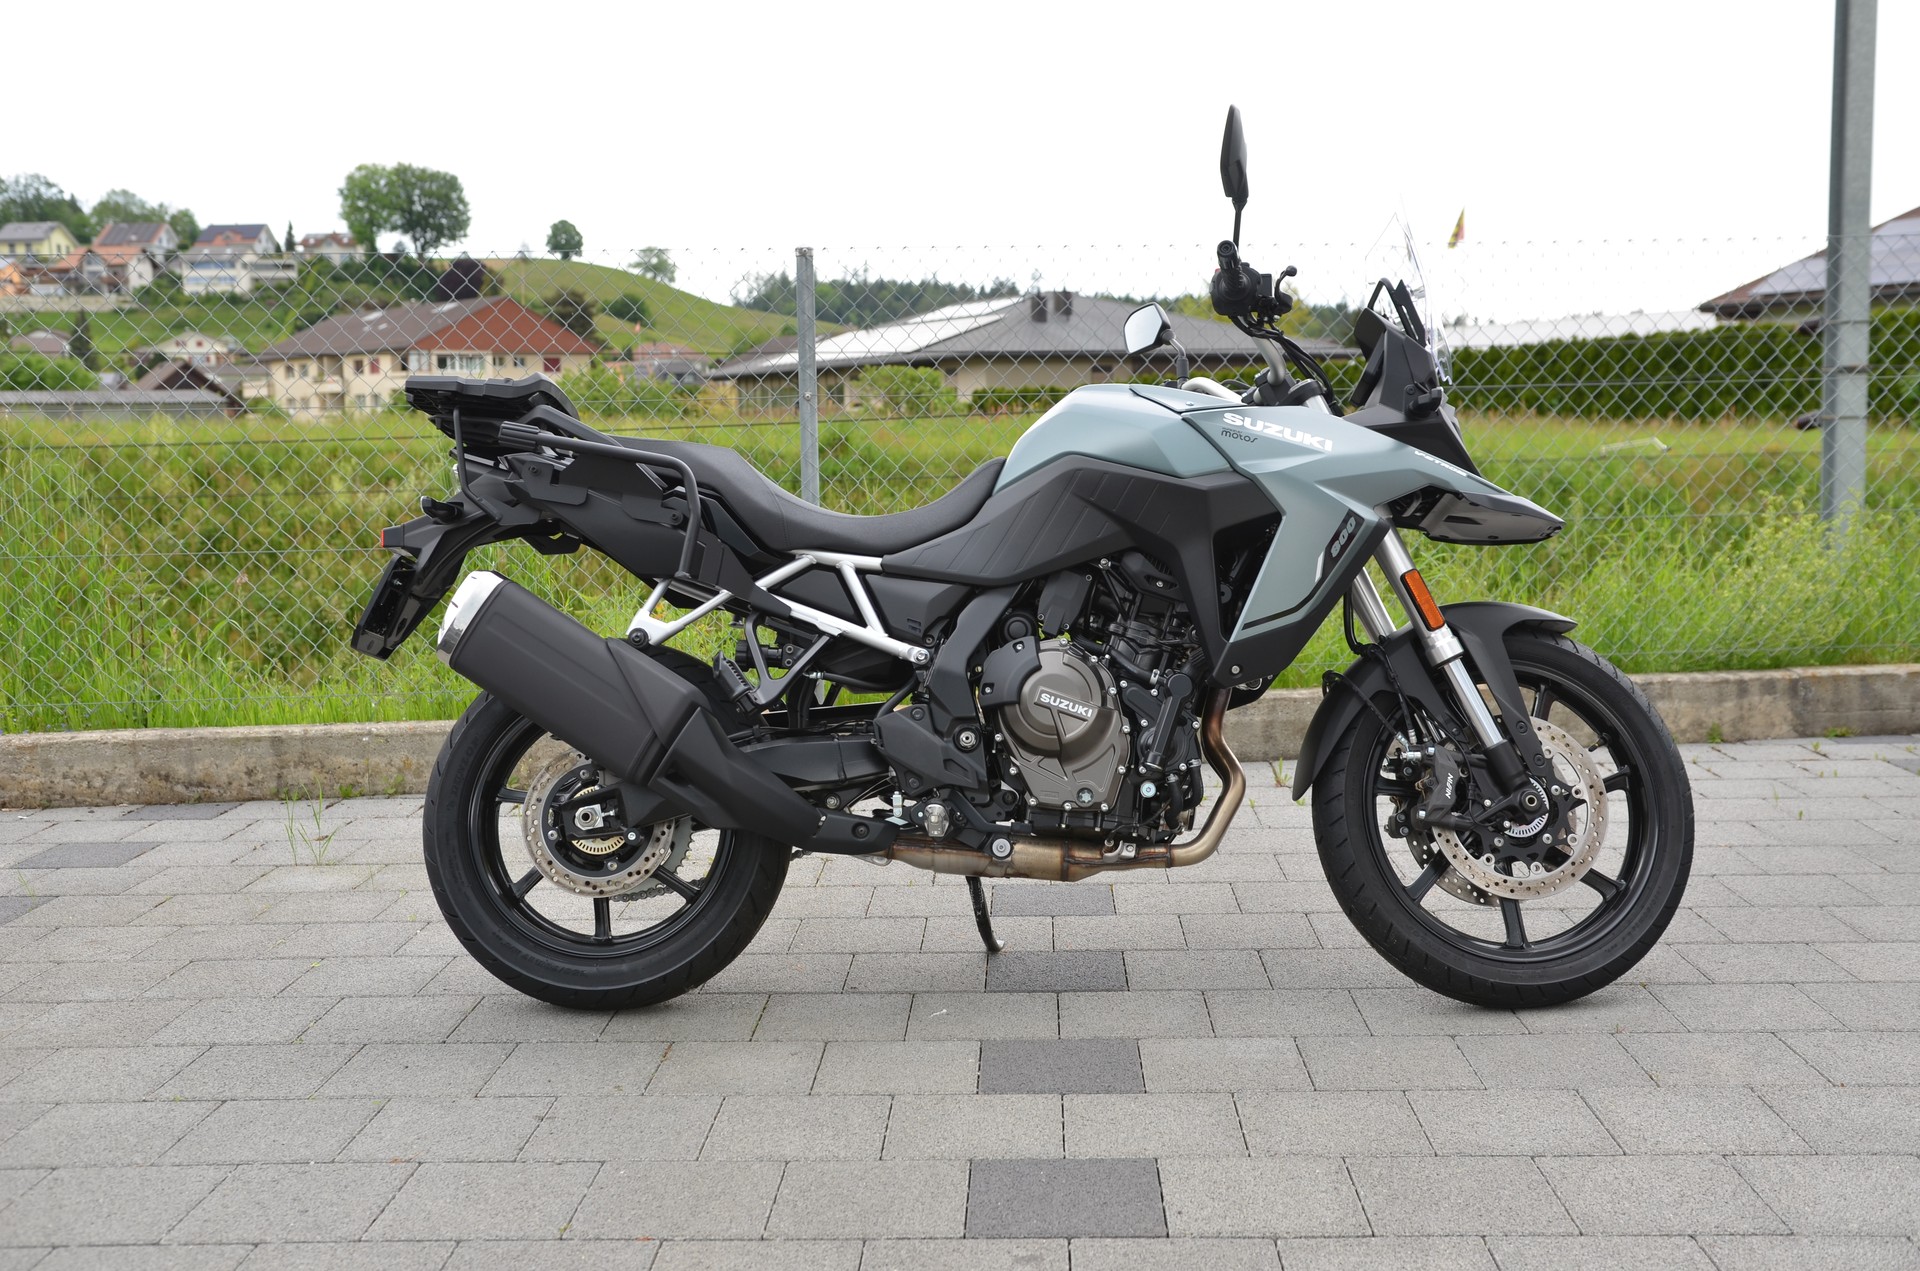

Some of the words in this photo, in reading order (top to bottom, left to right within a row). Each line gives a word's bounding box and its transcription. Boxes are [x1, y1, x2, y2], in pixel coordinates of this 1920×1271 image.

[1223, 412, 1333, 452] SUZUKI
[1330, 516, 1356, 558] 800
[1040, 693, 1093, 718] SUZUKI
